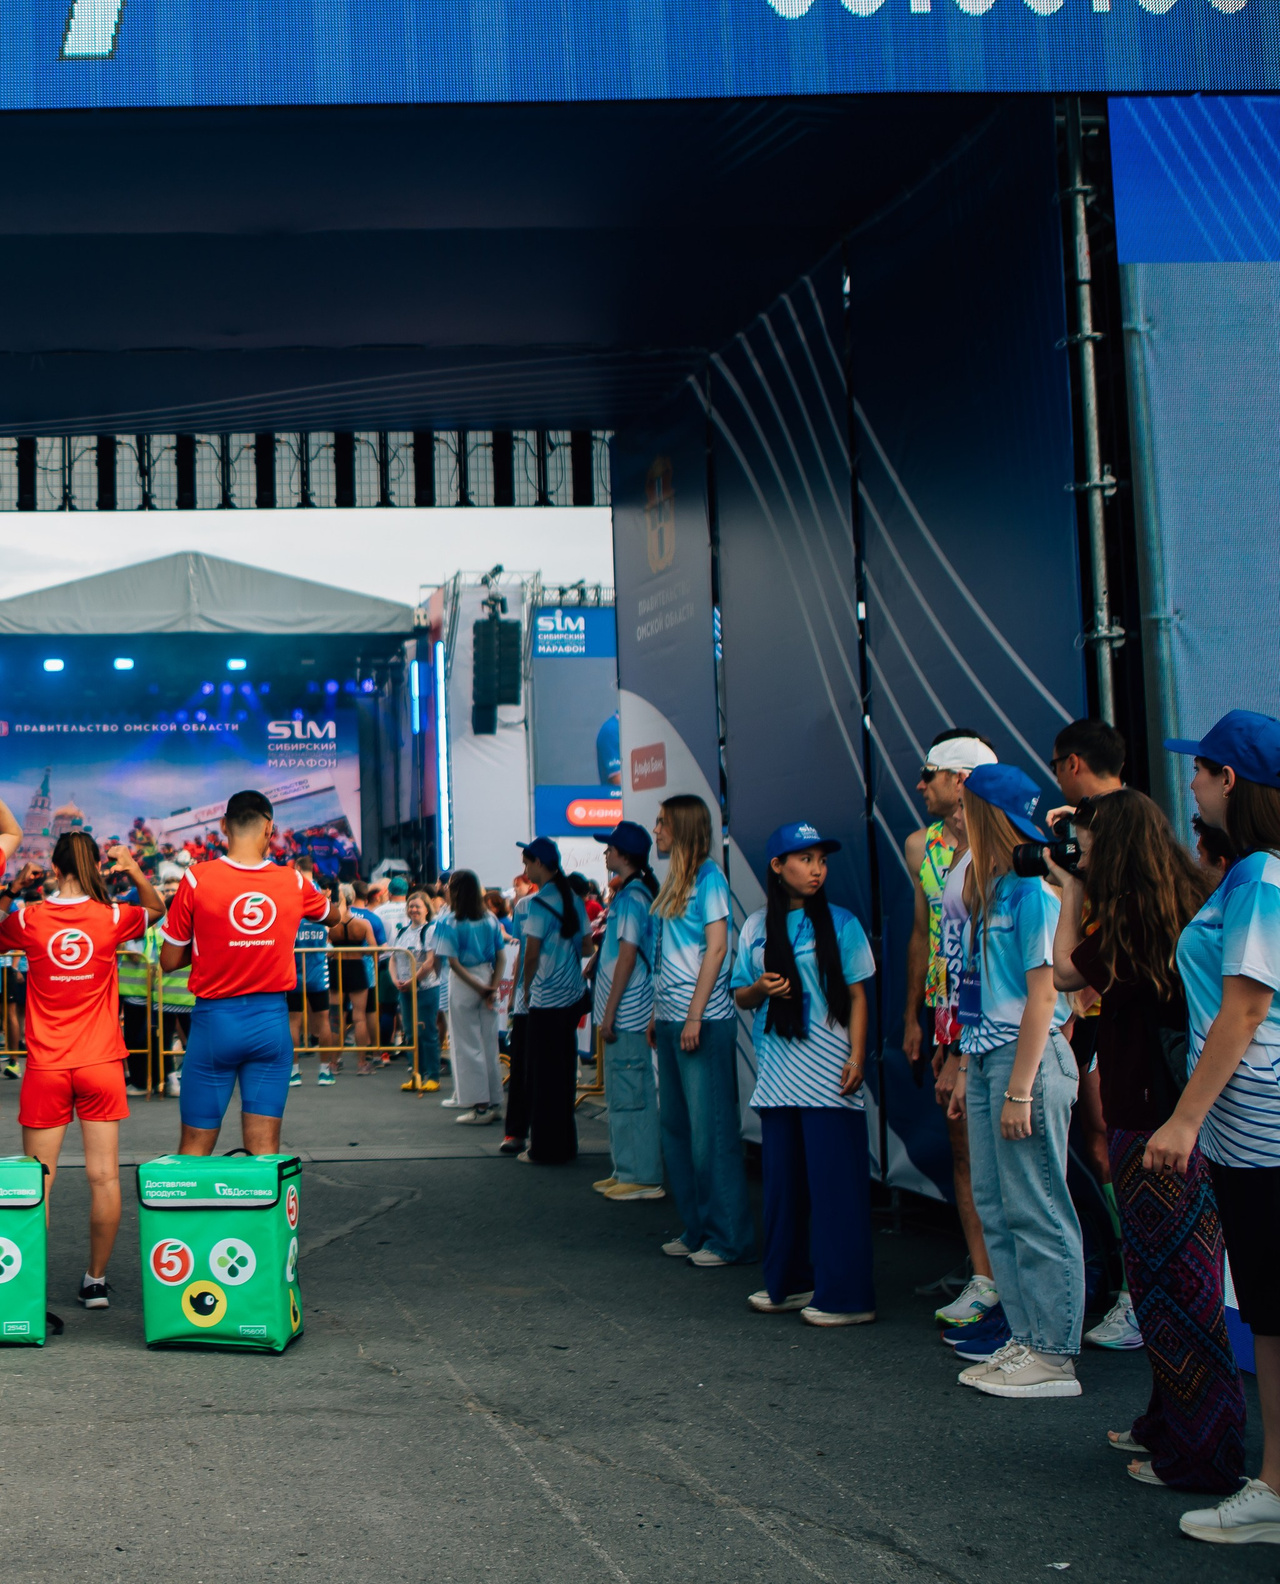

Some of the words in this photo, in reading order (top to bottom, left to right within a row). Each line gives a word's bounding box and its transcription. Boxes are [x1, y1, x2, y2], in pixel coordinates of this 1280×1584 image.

[538, 632, 585, 640] СИБИРСКИЙ
[538, 645, 585, 653] МАРАФОН
[15, 724, 119, 732] ПРАВИТЕЛЬСТВО
[124, 721, 177, 732] ОМСКОЙ
[182, 723, 239, 731] ОБЛАСТИ
[268, 741, 336, 751] СИБИРСКИЙ
[268, 758, 337, 768] МАРАФОН
[242, 896, 266, 926] 5
[60, 932, 82, 962] 5
[228, 939, 275, 948] выручает!
[145, 1180, 197, 1188] Доставляем
[160, 1243, 185, 1276] 5
